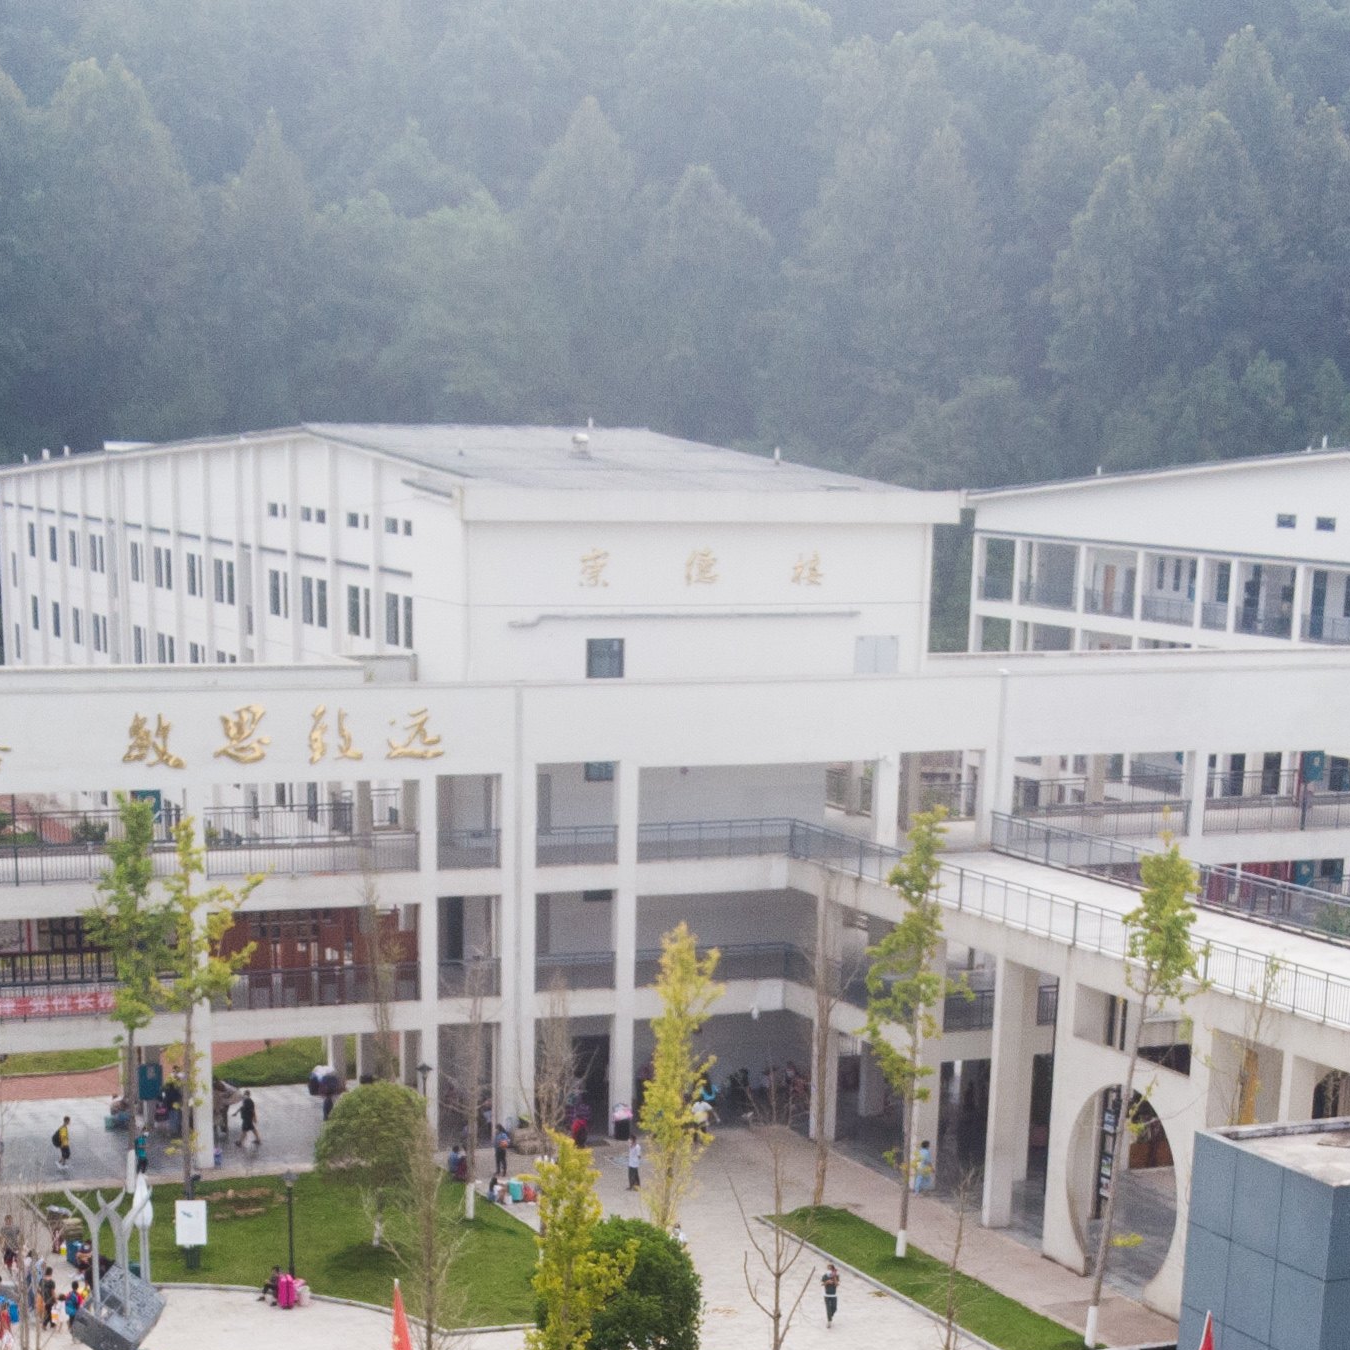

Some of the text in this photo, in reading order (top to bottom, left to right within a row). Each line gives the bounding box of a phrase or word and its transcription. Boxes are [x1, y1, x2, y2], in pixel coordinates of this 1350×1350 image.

[578, 546, 824, 588] 崇德楼
[122, 703, 445, 769] 敏思致远
